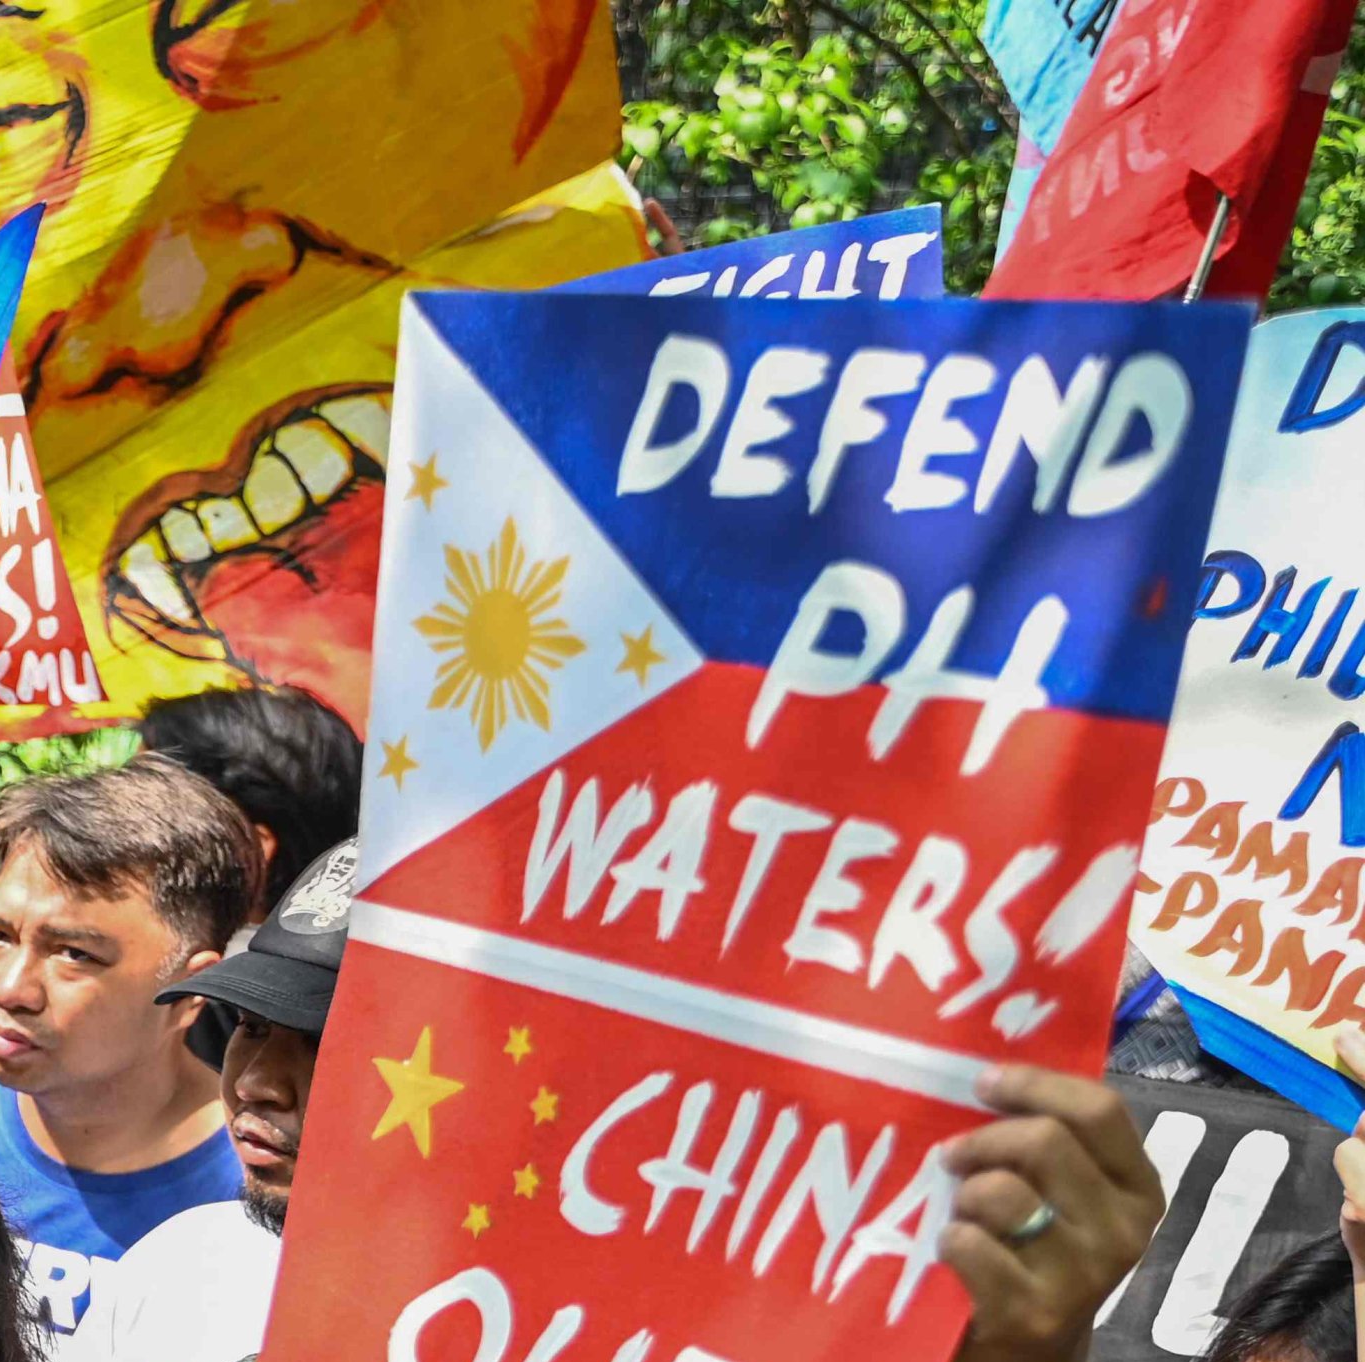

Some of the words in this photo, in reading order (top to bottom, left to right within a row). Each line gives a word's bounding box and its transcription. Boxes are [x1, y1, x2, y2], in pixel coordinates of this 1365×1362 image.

[649, 231, 939, 301] GHT
[616, 334, 1192, 519] DEFEND
[745, 561, 1069, 776] PH
[520, 768, 1139, 1041] WATERS!
[559, 1070, 956, 1327] CHINA
